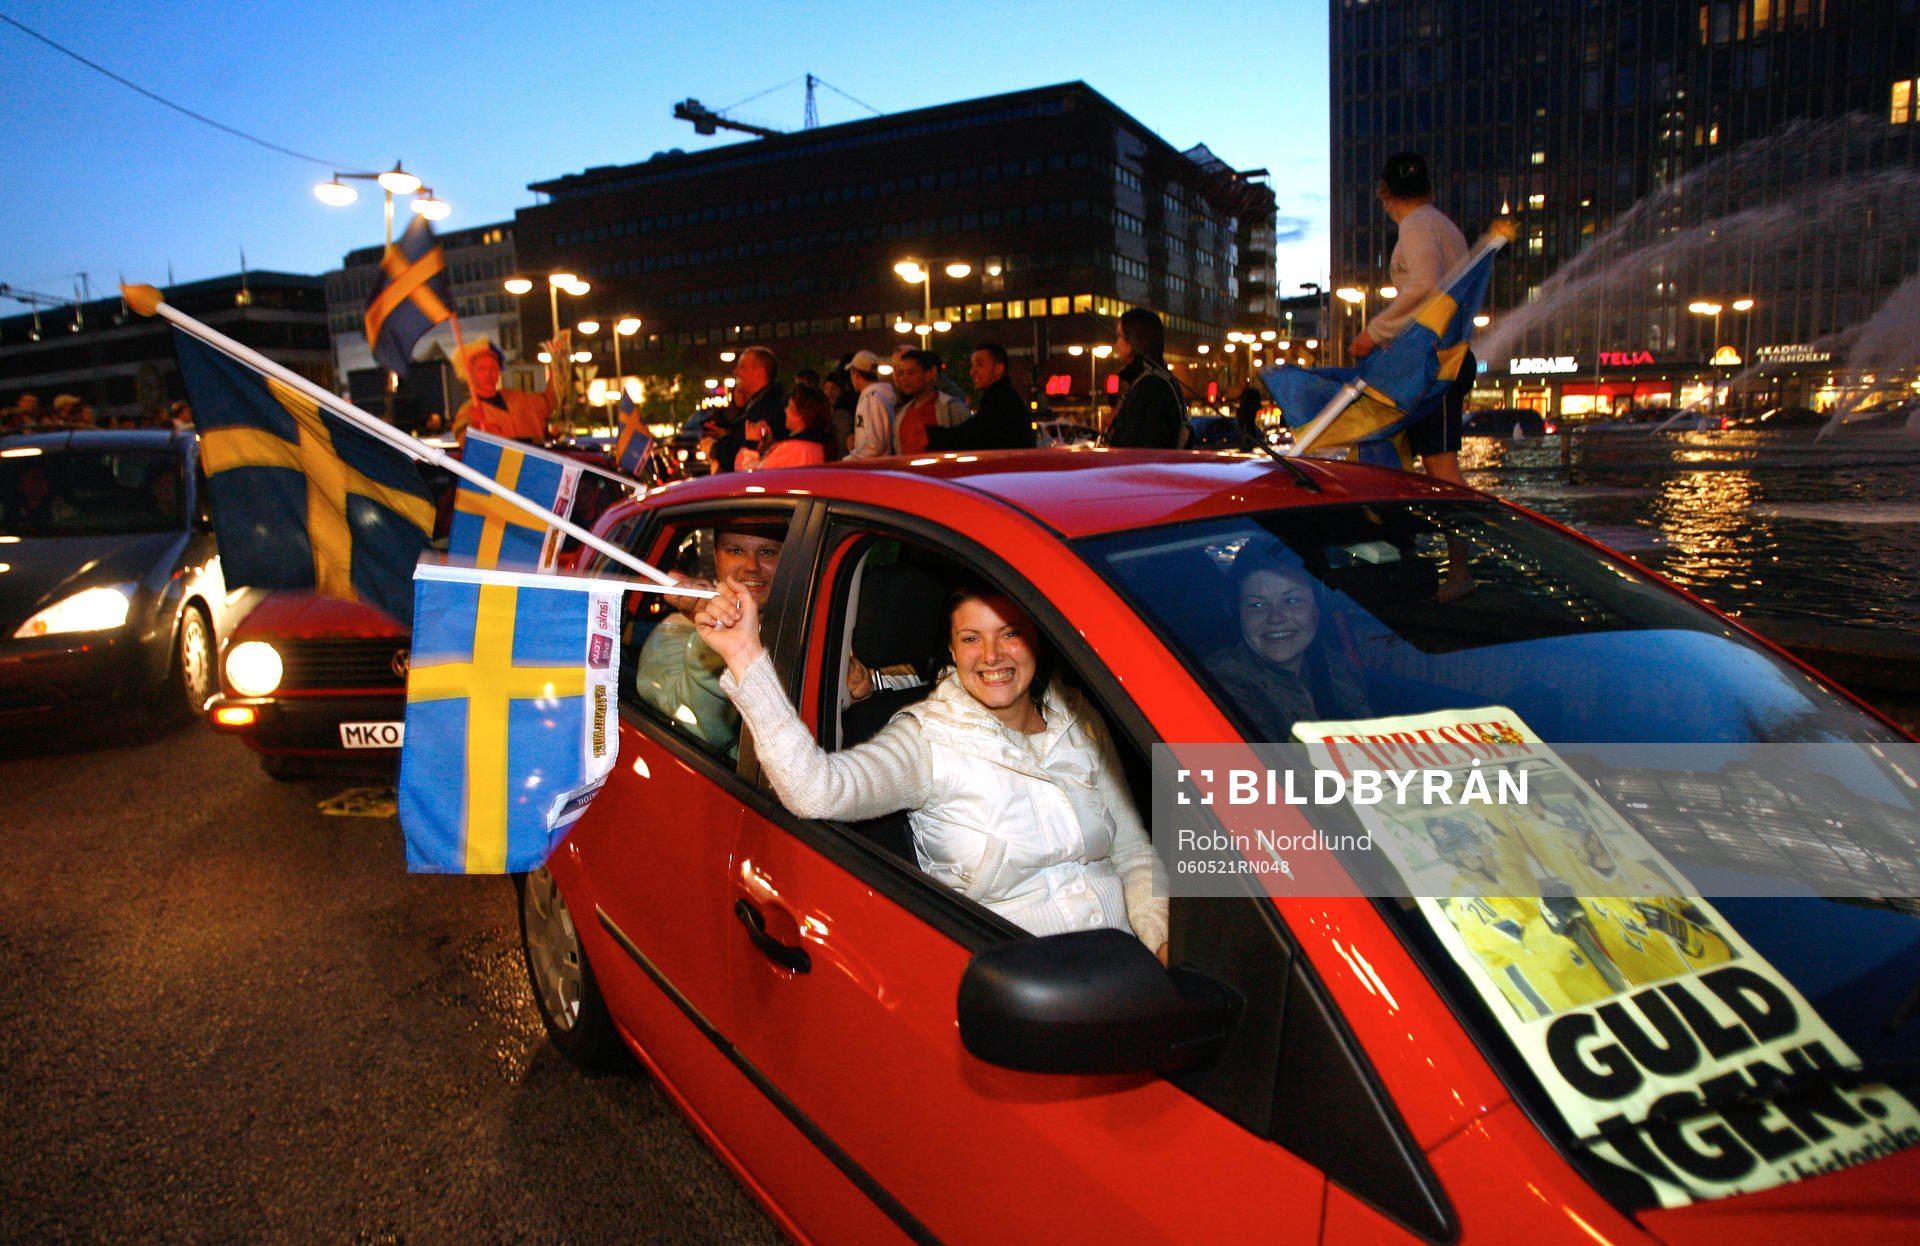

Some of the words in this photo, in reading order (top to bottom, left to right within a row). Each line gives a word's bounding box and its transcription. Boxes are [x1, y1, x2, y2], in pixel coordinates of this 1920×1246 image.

[1600, 352, 1655, 366] TELIA
[345, 725, 399, 745] MKO
[1546, 966, 1799, 1101] GULD
